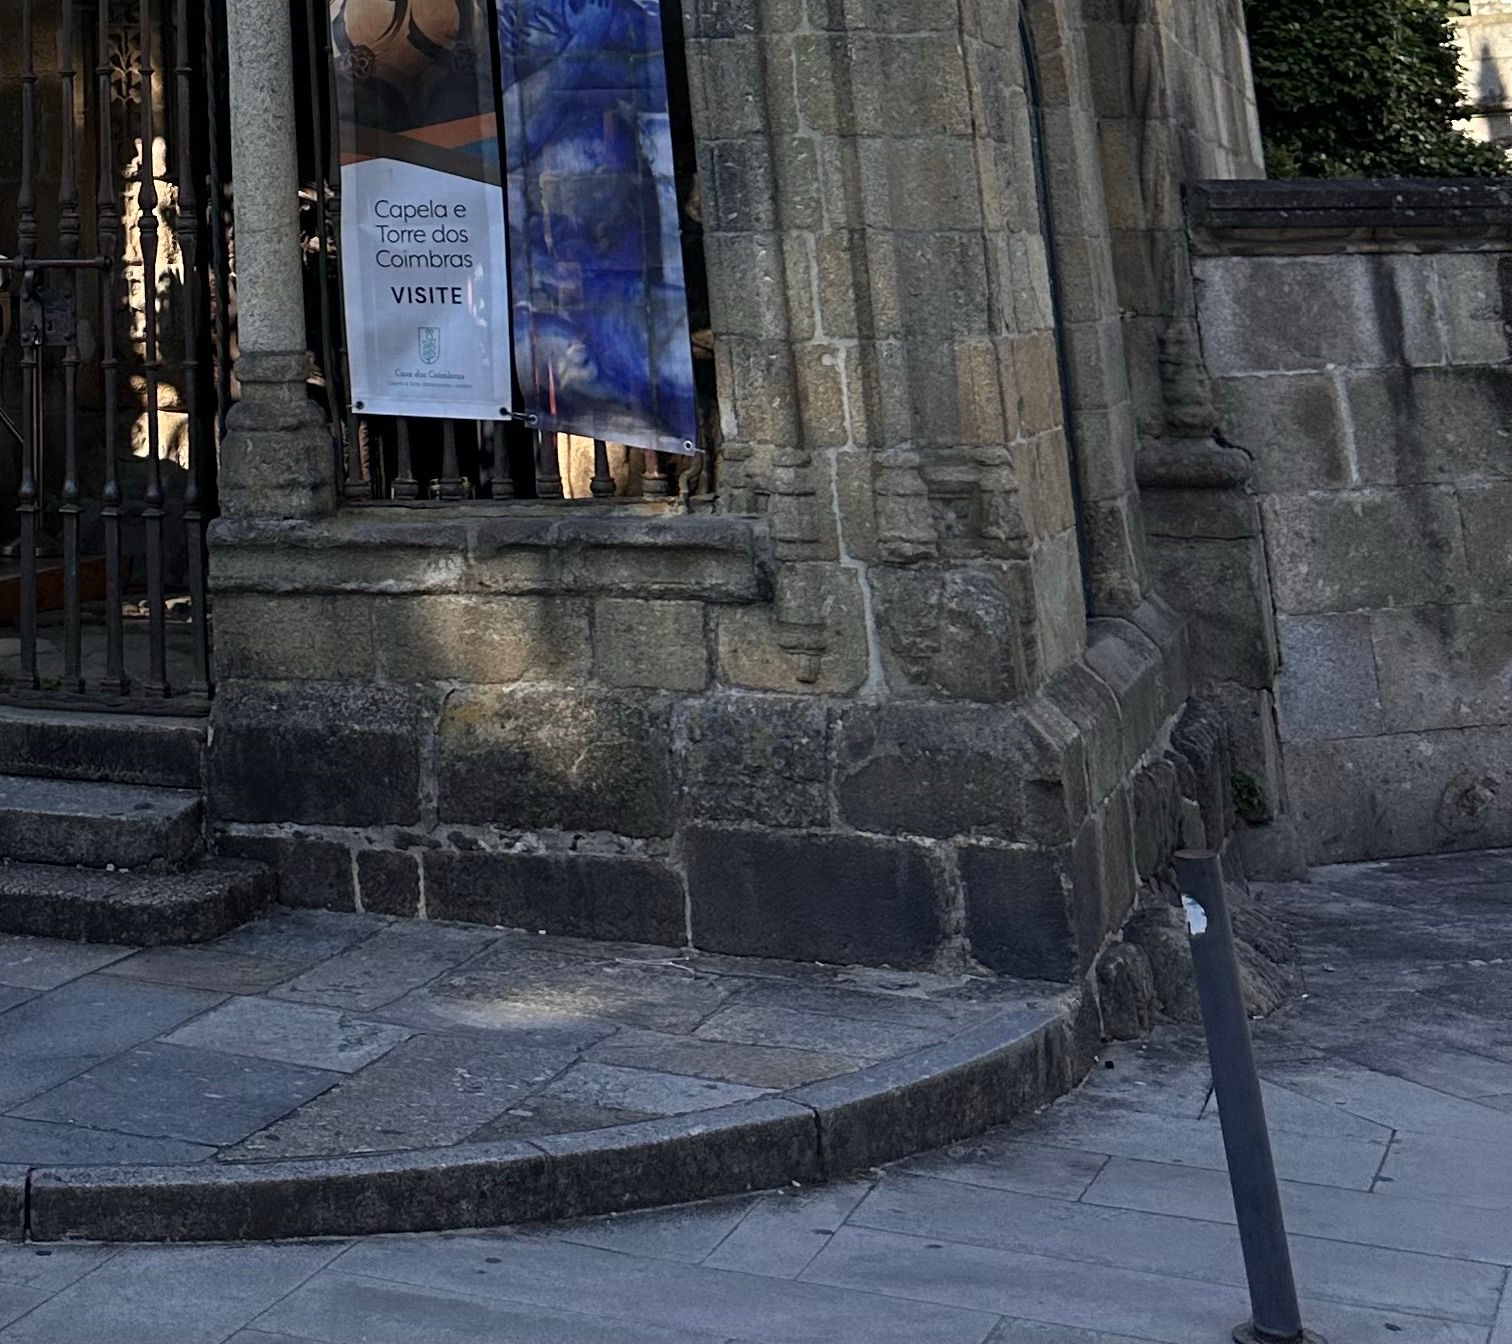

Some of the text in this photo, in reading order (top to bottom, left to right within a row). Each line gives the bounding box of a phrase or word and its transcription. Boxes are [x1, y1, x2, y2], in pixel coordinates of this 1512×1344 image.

[374, 199, 467, 223] Capela e
[375, 224, 469, 244] Torre dos
[375, 249, 473, 268] Coimbras
[390, 286, 463, 305] VISITE
